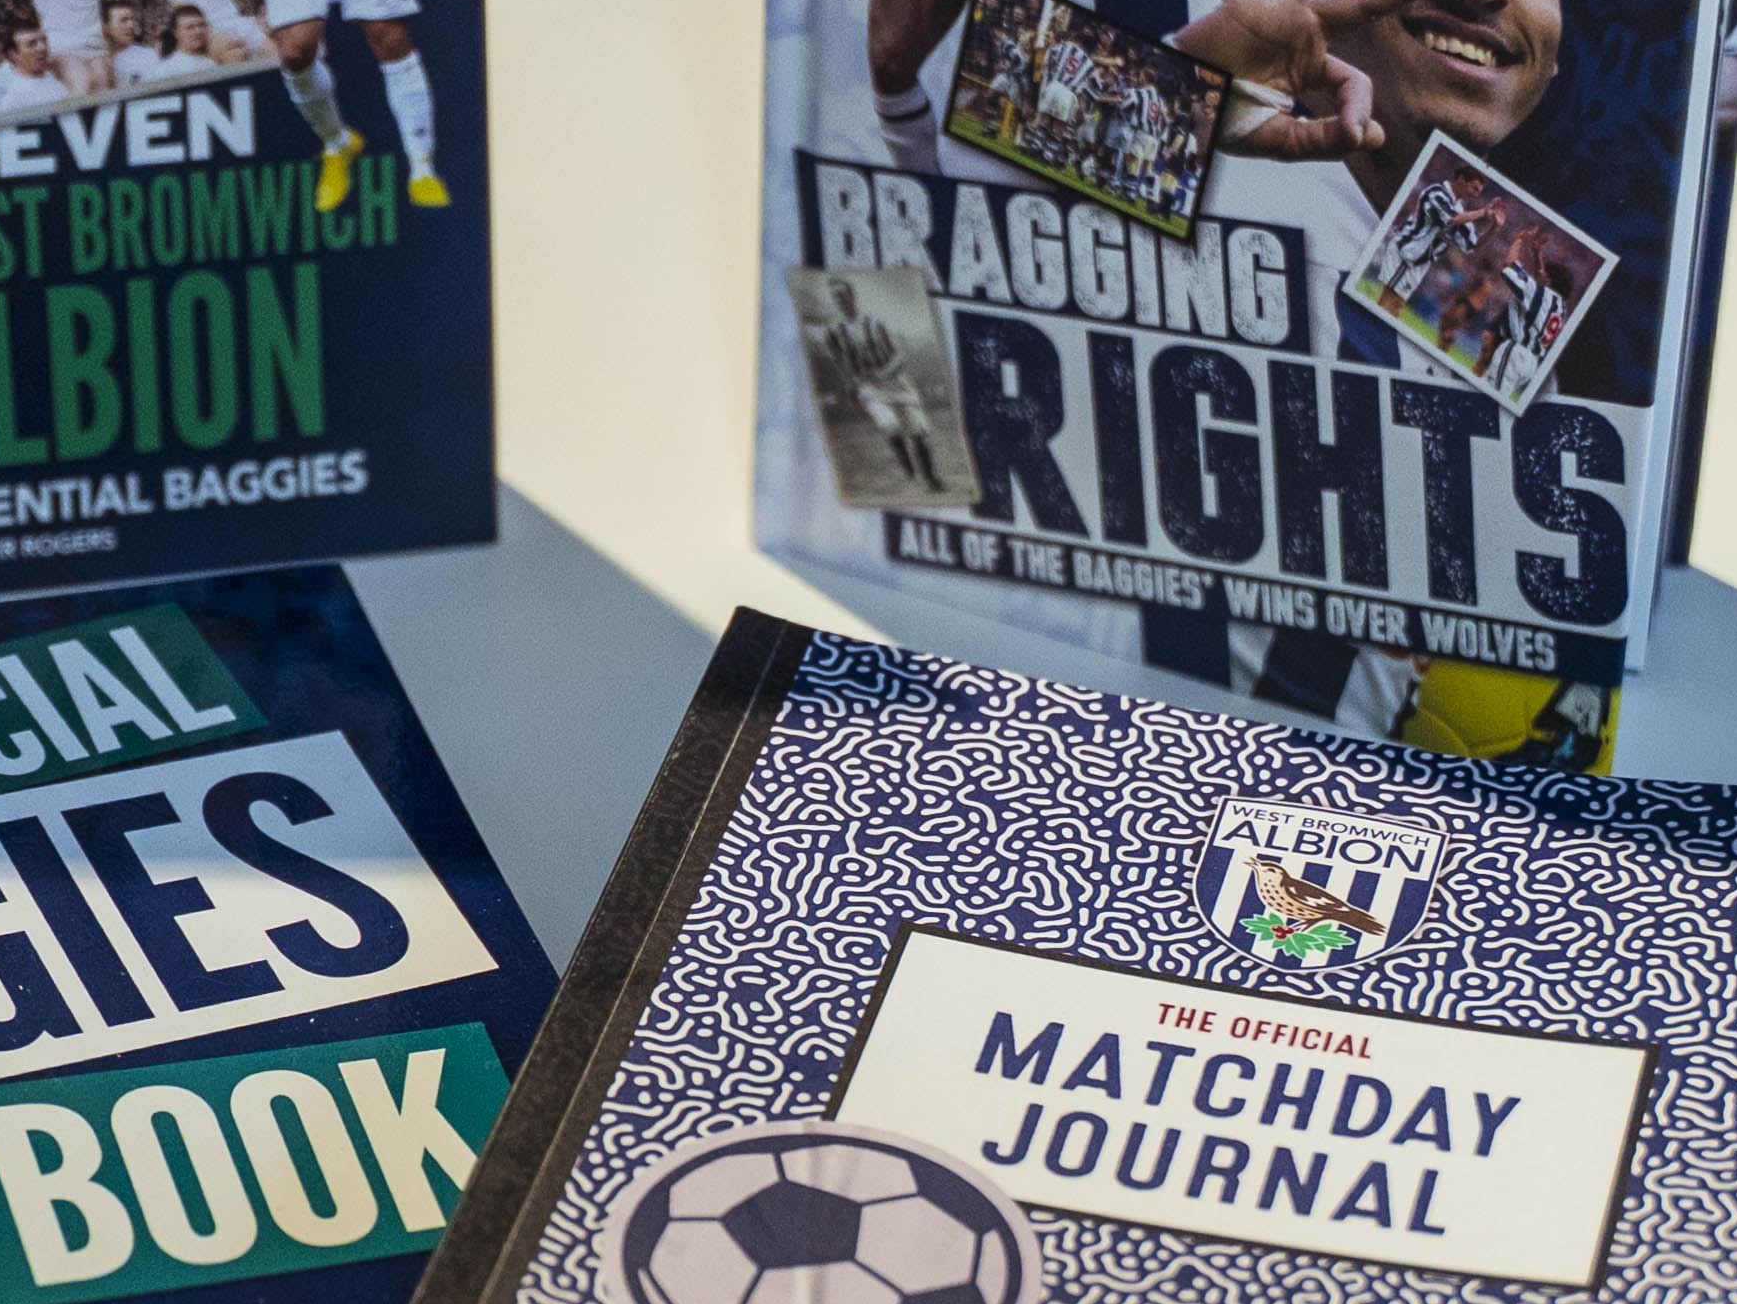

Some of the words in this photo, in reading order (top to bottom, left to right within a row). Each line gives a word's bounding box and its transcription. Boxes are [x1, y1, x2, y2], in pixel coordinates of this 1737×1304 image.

[815, 162, 1291, 346] BRAGGING
[164, 449, 370, 510] BAGGIES
[954, 309, 1630, 628] RIGHTS
[899, 519, 954, 563] ALL
[965, 533, 1001, 573] OF
[1007, 540, 1066, 584] THE
[1073, 552, 1216, 609] BAGGIES'
[1223, 577, 1316, 631] WINS
[1325, 600, 1410, 647] OVER
[1419, 611, 1557, 672] WOLVES
[1222, 820, 1426, 873] ALBION
[1232, 804, 1296, 825] WEST
[1302, 817, 1430, 847] BROMWICH
[974, 1011, 1521, 1157] MATCHDAY
[1158, 1003, 1217, 1033] THE
[1230, 1016, 1372, 1059] OFFICIAL
[981, 1103, 1447, 1235] JOURNAL
